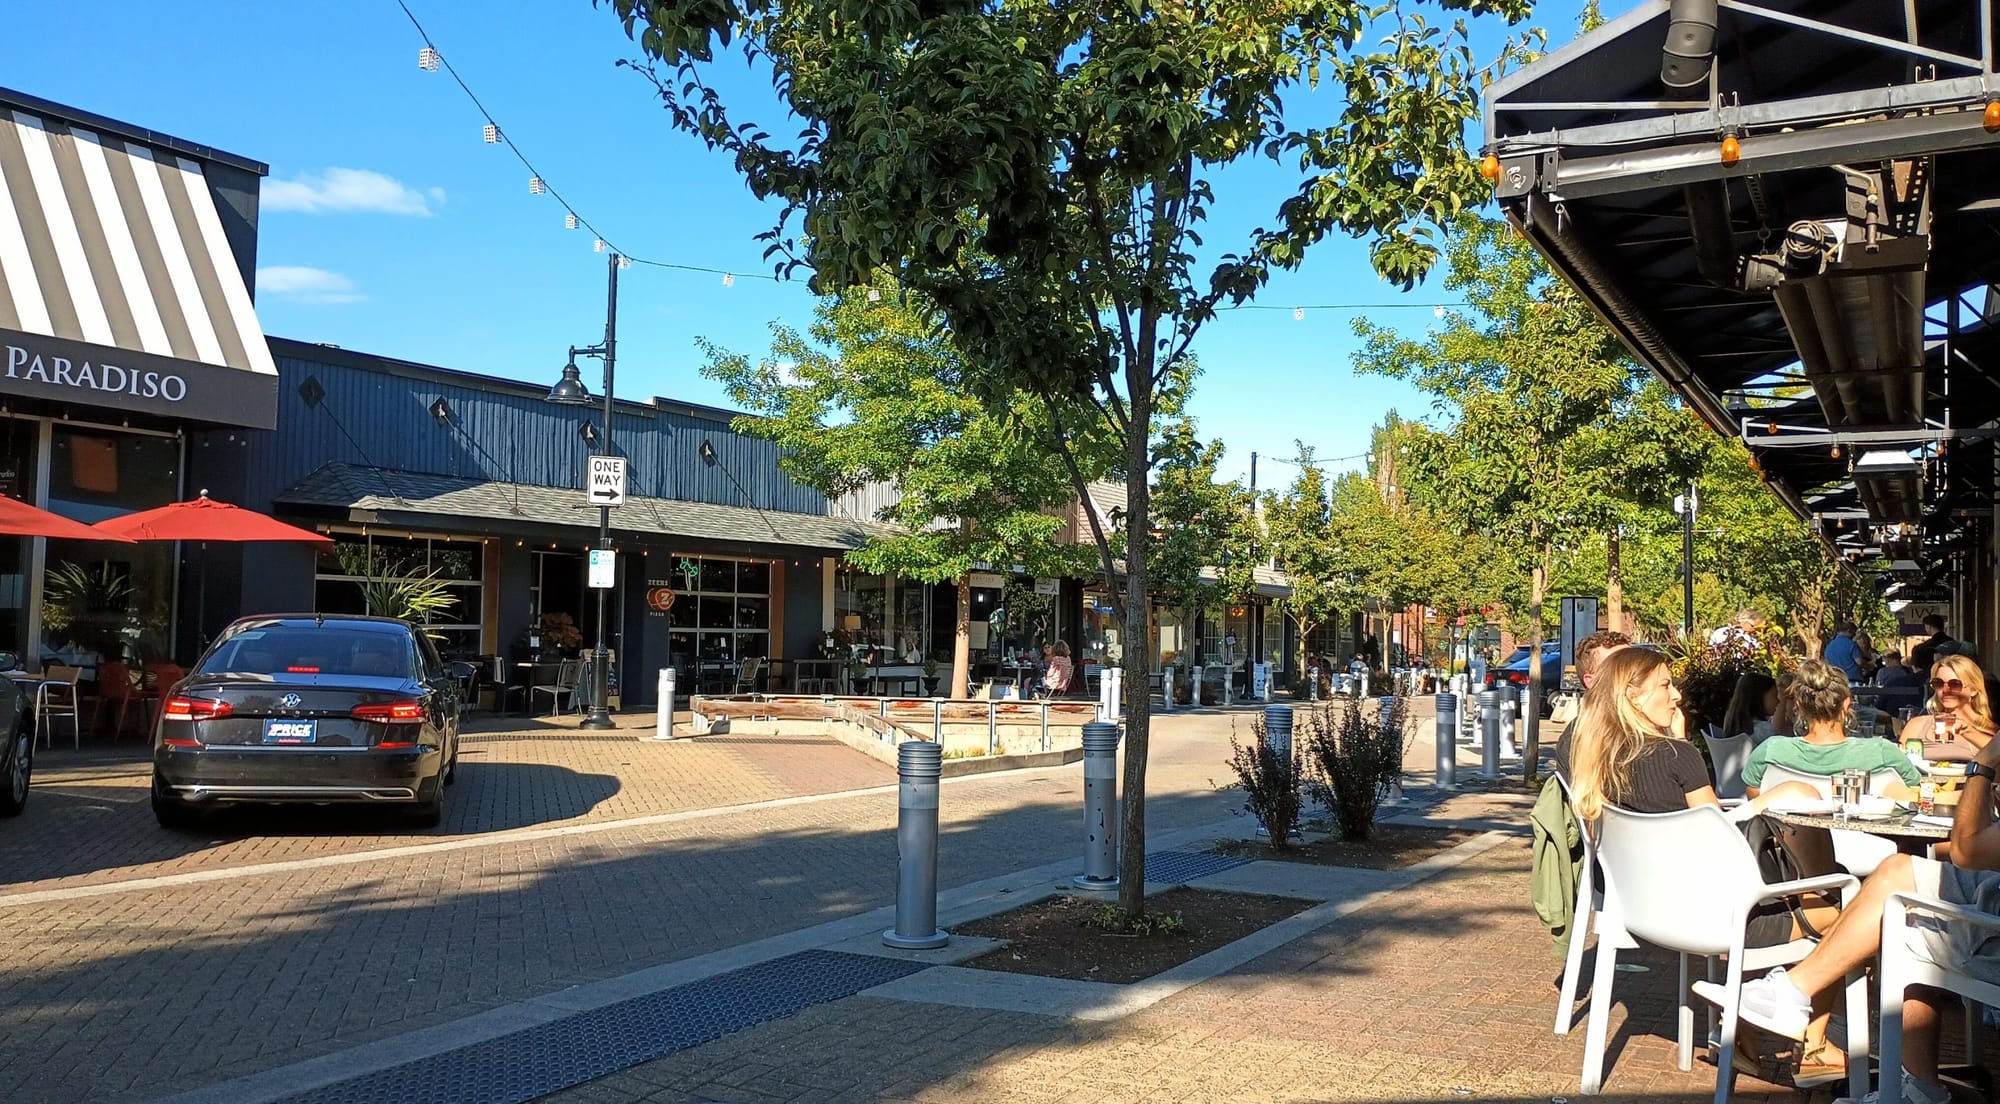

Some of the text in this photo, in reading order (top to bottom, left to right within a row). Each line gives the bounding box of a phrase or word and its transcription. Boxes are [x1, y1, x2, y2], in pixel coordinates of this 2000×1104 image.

[5, 345, 187, 402] PARADISO
[594, 460, 621, 473] ONE
[594, 474, 621, 487] WAY
